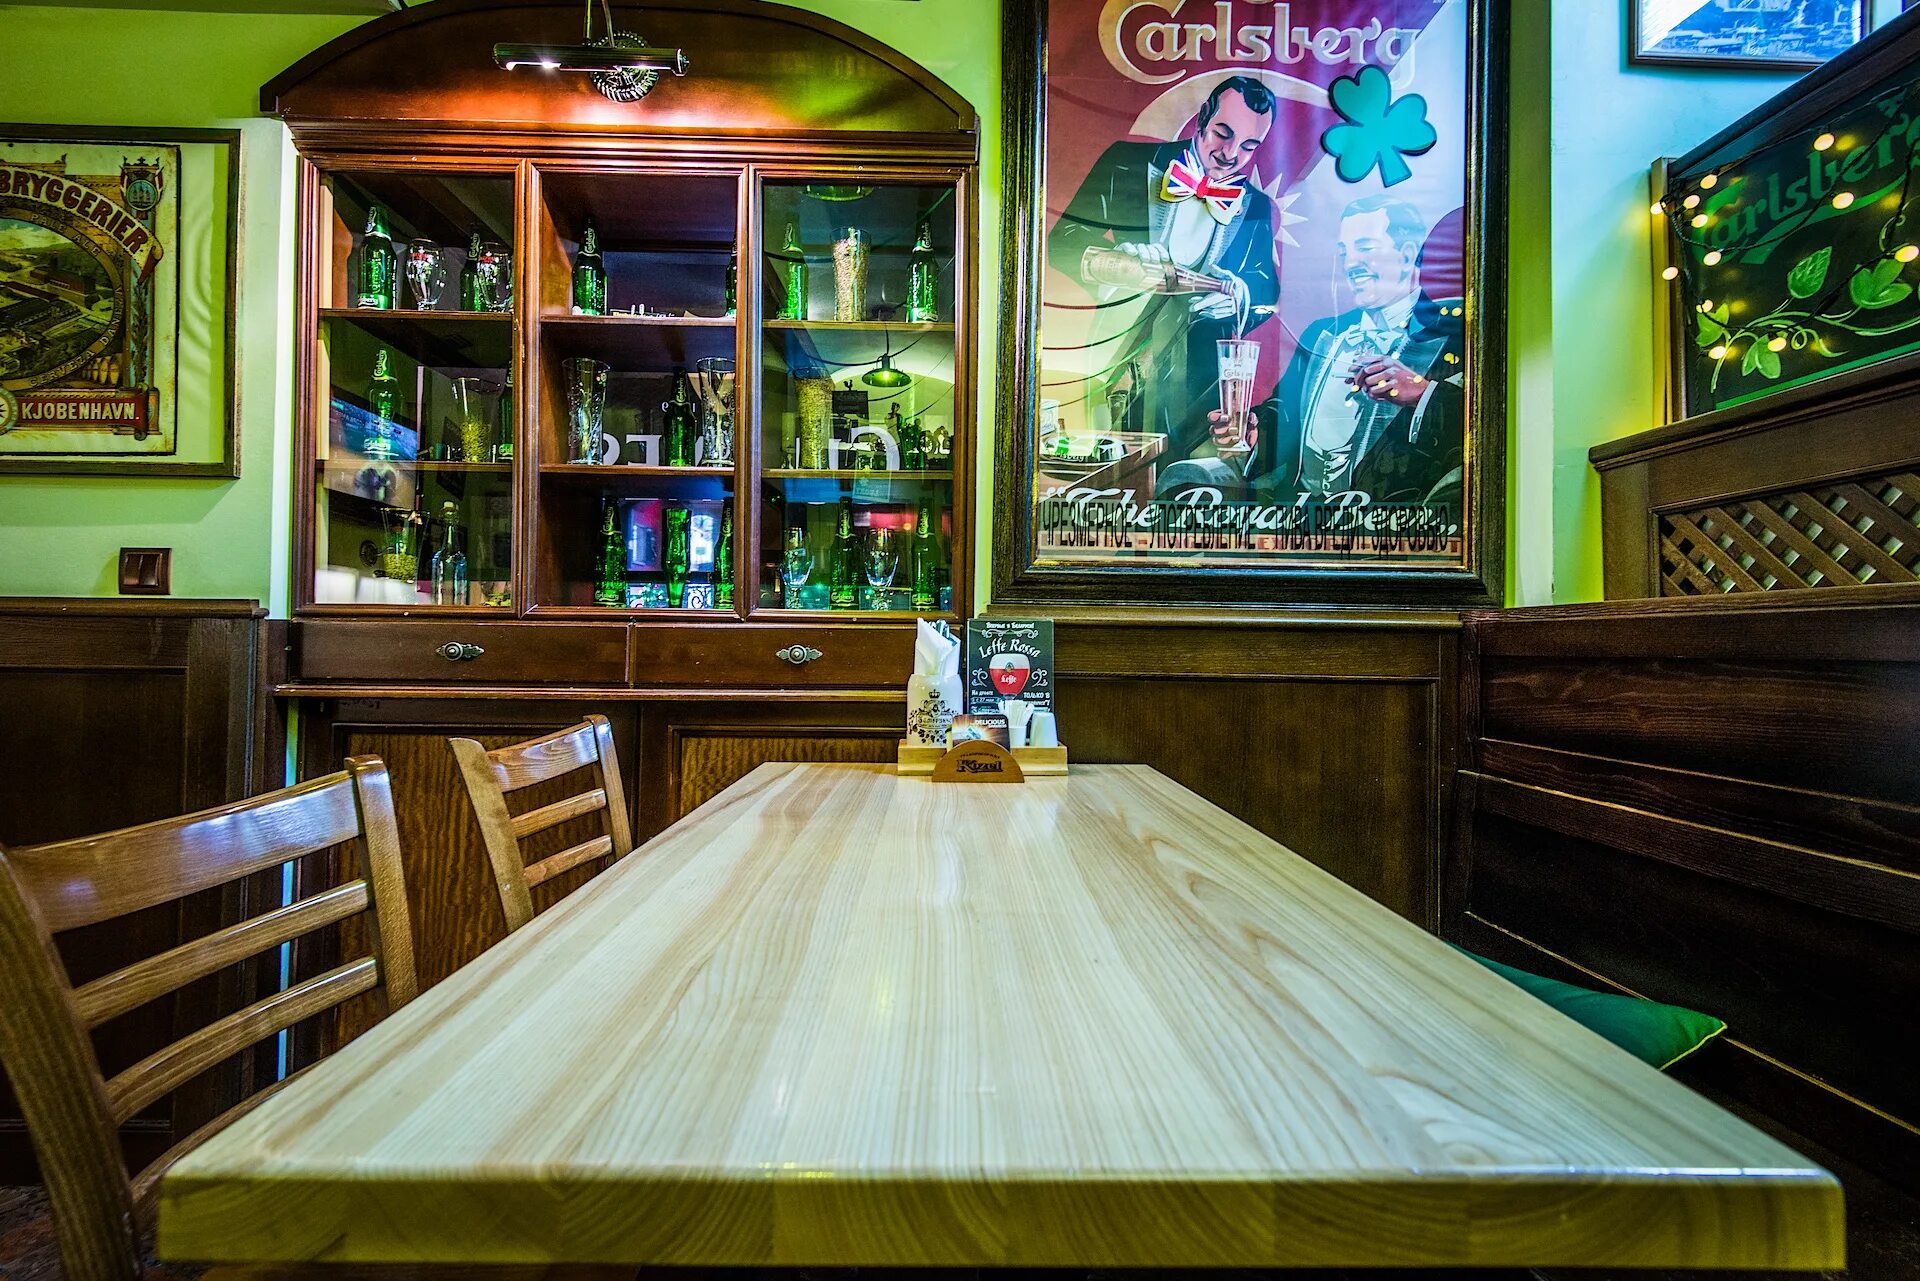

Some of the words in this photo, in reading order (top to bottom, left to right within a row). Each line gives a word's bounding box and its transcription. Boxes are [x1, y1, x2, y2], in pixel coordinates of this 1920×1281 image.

[1098, 0, 1423, 90] Carlsberg
[1690, 86, 1920, 265] Carlsber
[30, 213, 67, 234] PALE
[71, 233, 101, 258] ALE
[582, 227, 595, 254] Carlsberg
[30, 349, 96, 387] CERVEZA
[373, 350, 387, 377] Carlsberg
[595, 590, 620, 603] Carlsberg
[831, 592, 856, 605] Carlsberg
[911, 593, 935, 605] Carlsberg
[978, 637, 1007, 659] Leffe
[1009, 638, 1041, 658] Rossa
[1000, 674, 1017, 685] Leffe
[956, 759, 1004, 774] Kozel
